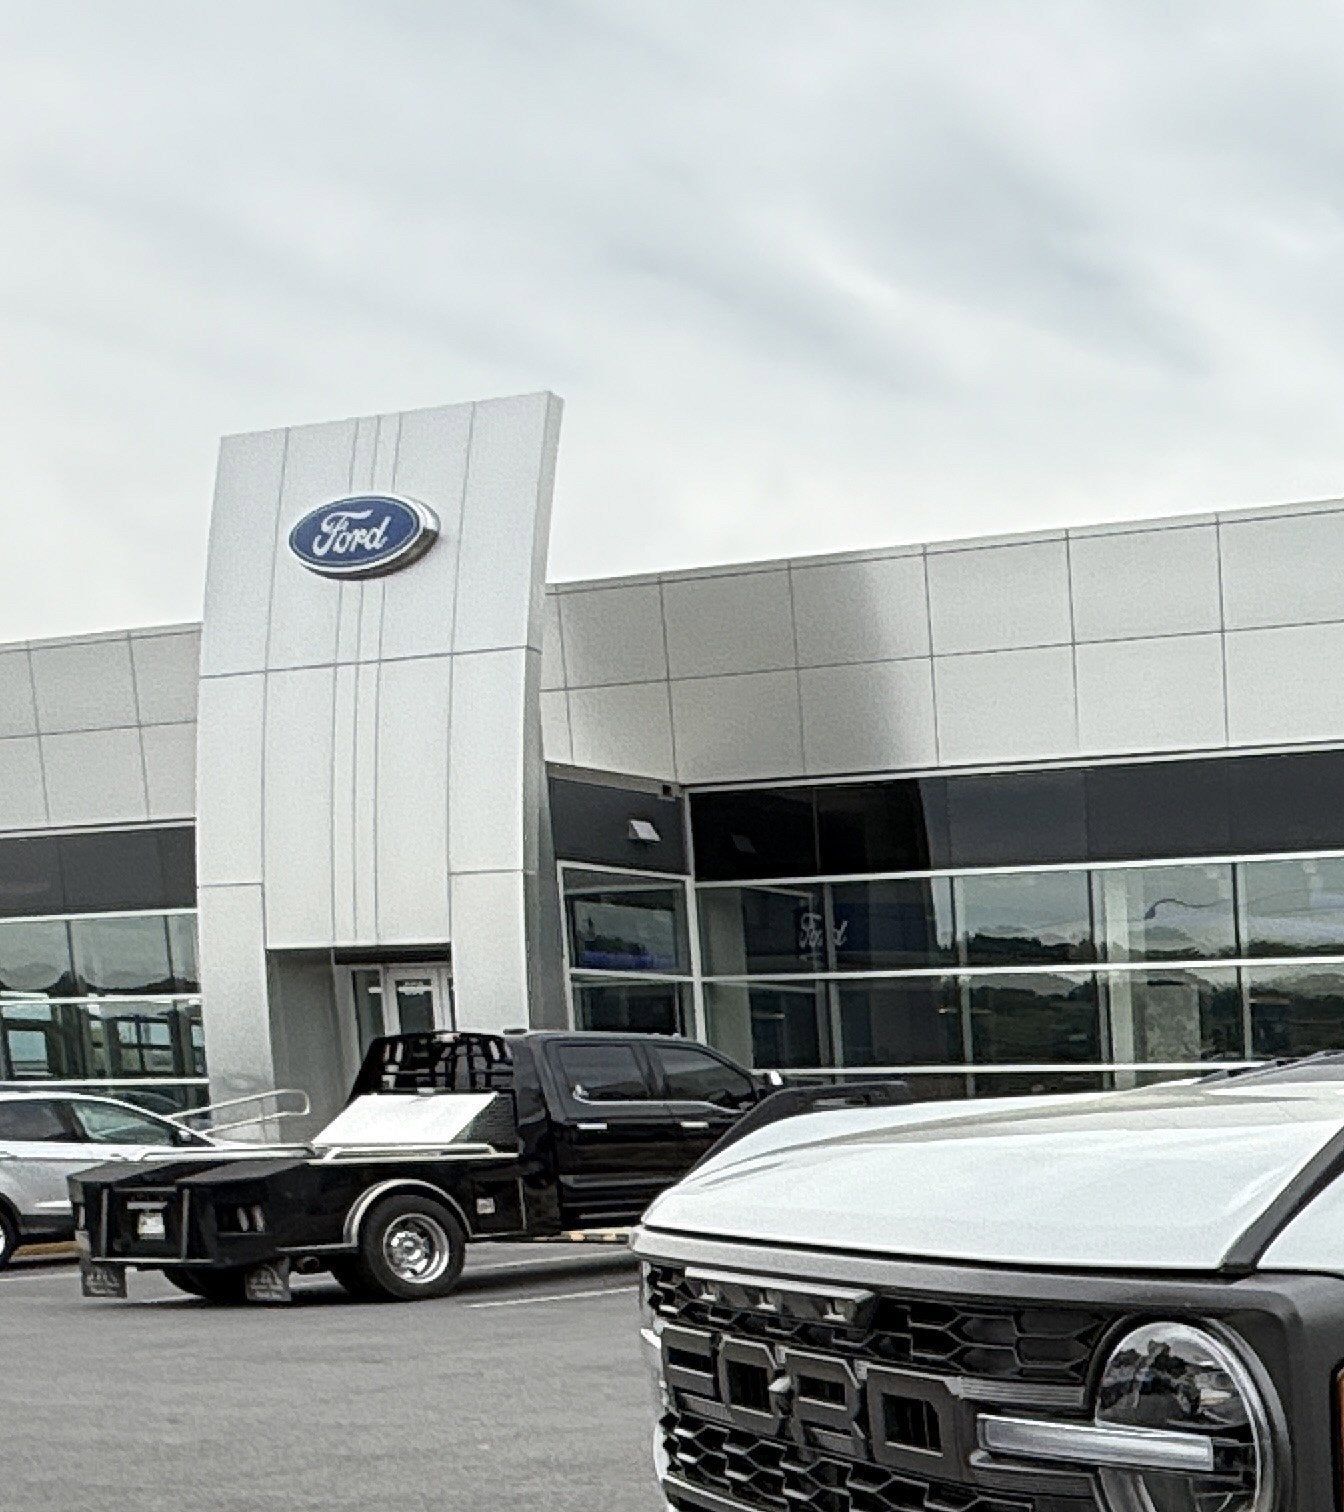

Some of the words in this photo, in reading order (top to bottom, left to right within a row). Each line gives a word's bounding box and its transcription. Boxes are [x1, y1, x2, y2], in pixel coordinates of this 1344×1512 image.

[312, 509, 392, 556] Ford
[799, 912, 848, 948] Fod
[661, 1322, 962, 1482] FORD
